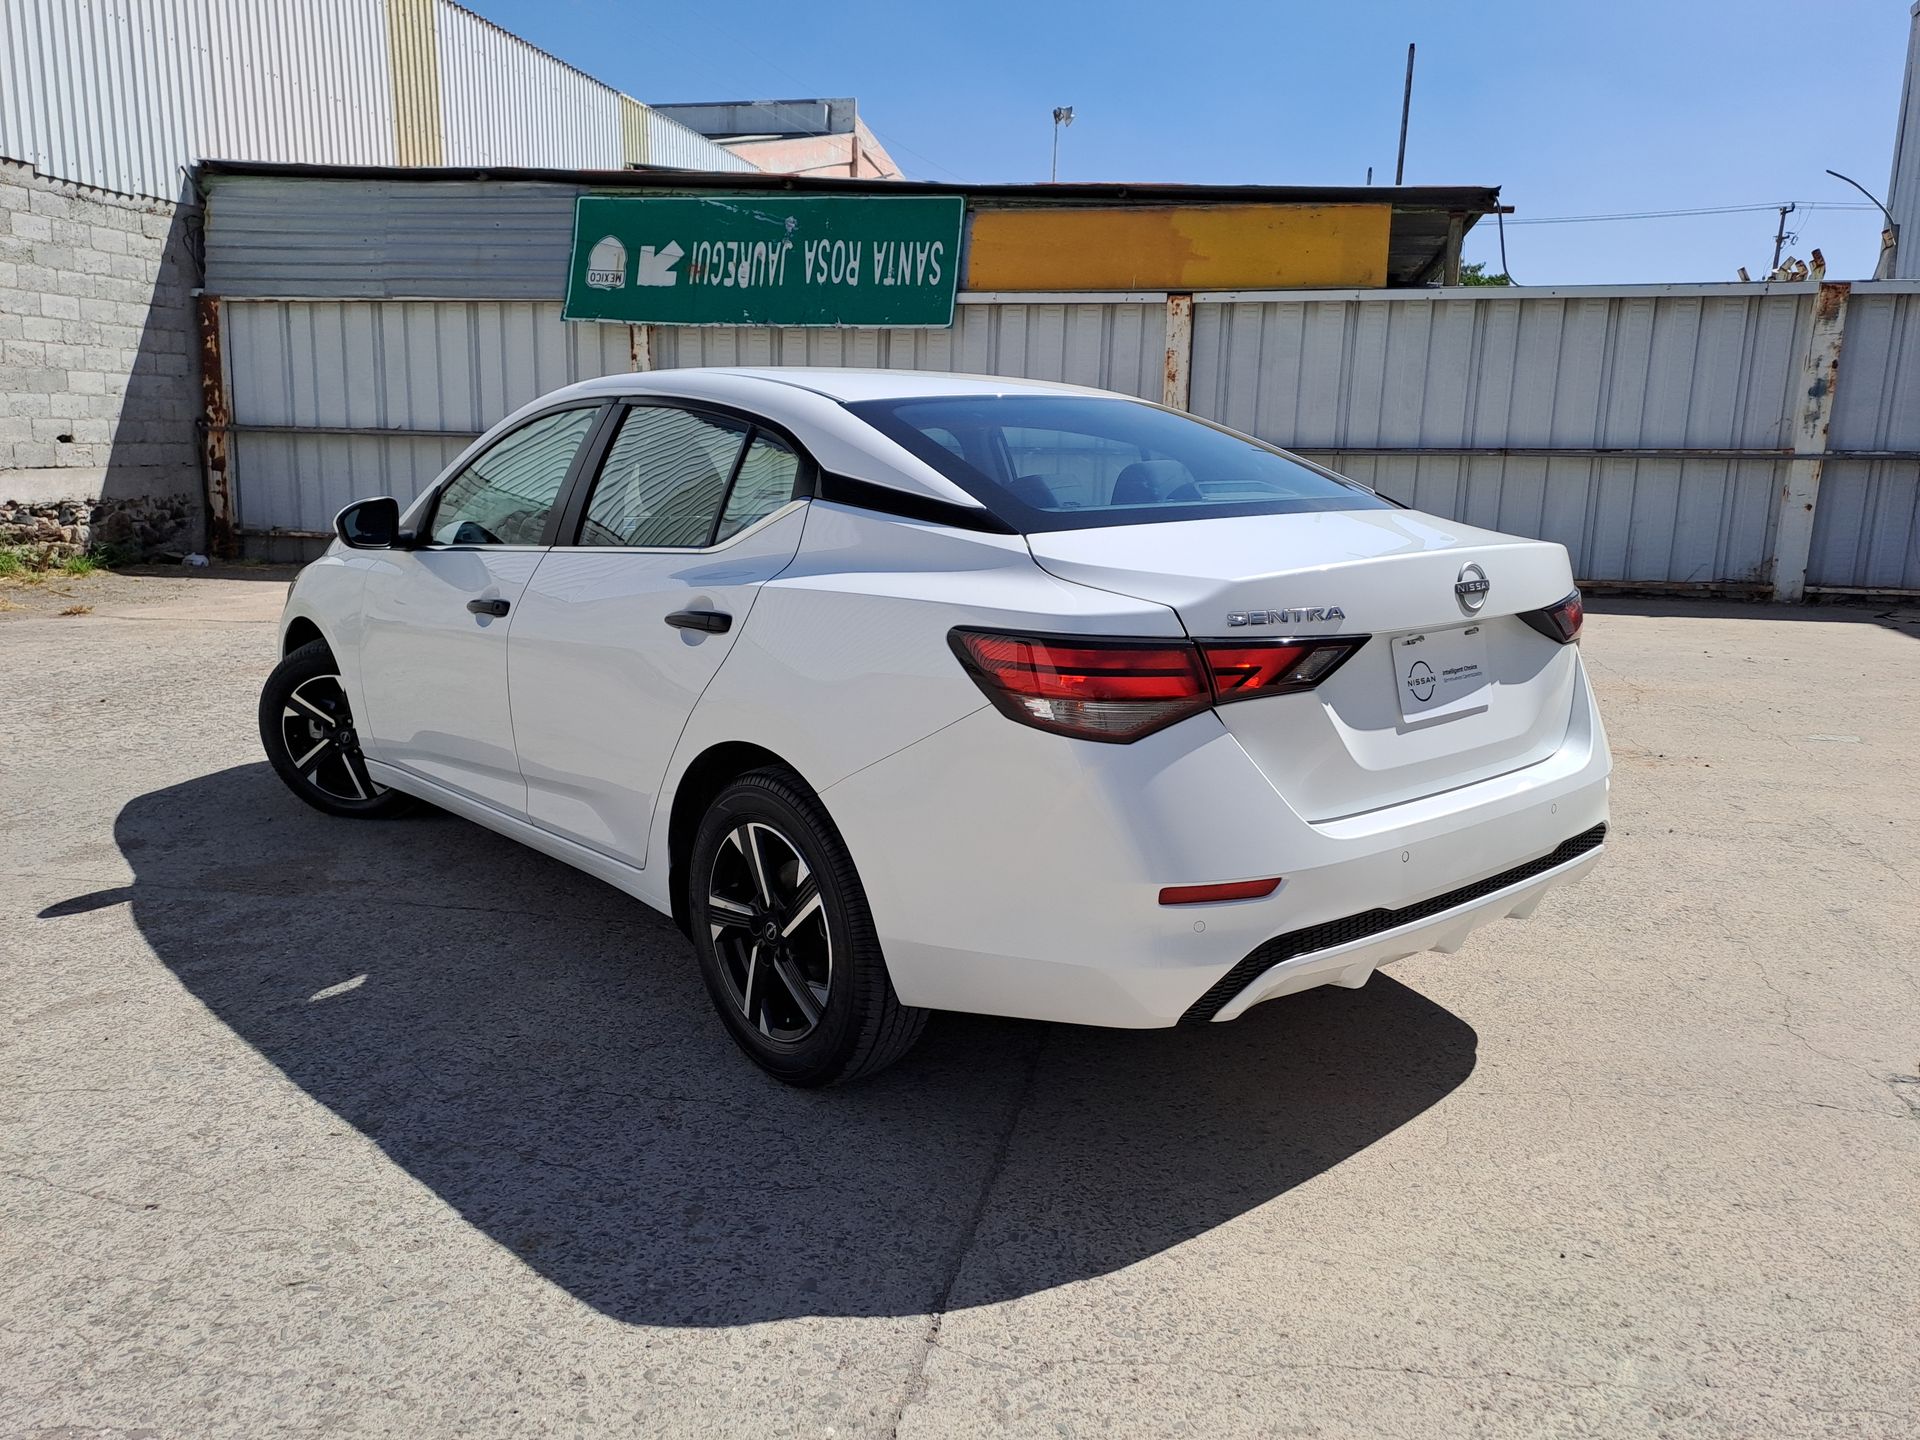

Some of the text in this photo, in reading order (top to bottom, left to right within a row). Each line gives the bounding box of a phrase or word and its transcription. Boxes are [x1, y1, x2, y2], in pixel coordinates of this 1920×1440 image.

[689, 238, 944, 288] SANTA ROSA JAUREGUI
[590, 272, 622, 283] MEXICO
[1227, 606, 1345, 627] SENTRA
[1407, 675, 1436, 688] NISSAN
